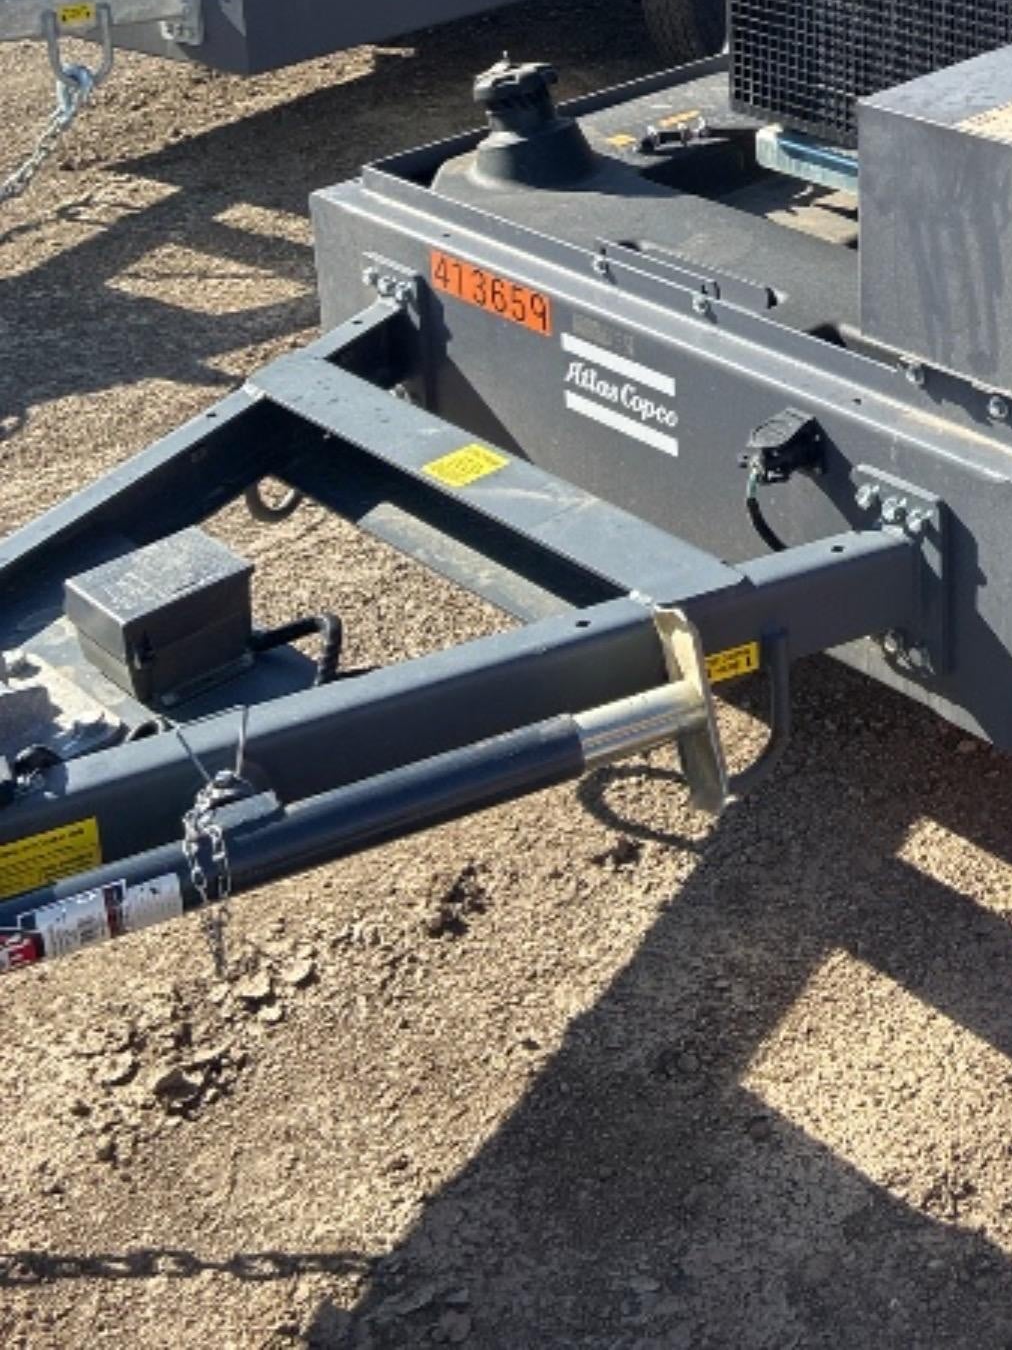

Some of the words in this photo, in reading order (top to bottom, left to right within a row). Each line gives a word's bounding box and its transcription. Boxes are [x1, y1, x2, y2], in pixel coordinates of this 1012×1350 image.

[433, 256, 548, 332] 413659
[564, 361, 618, 403] Atlas
[619, 383, 679, 427] Copco
